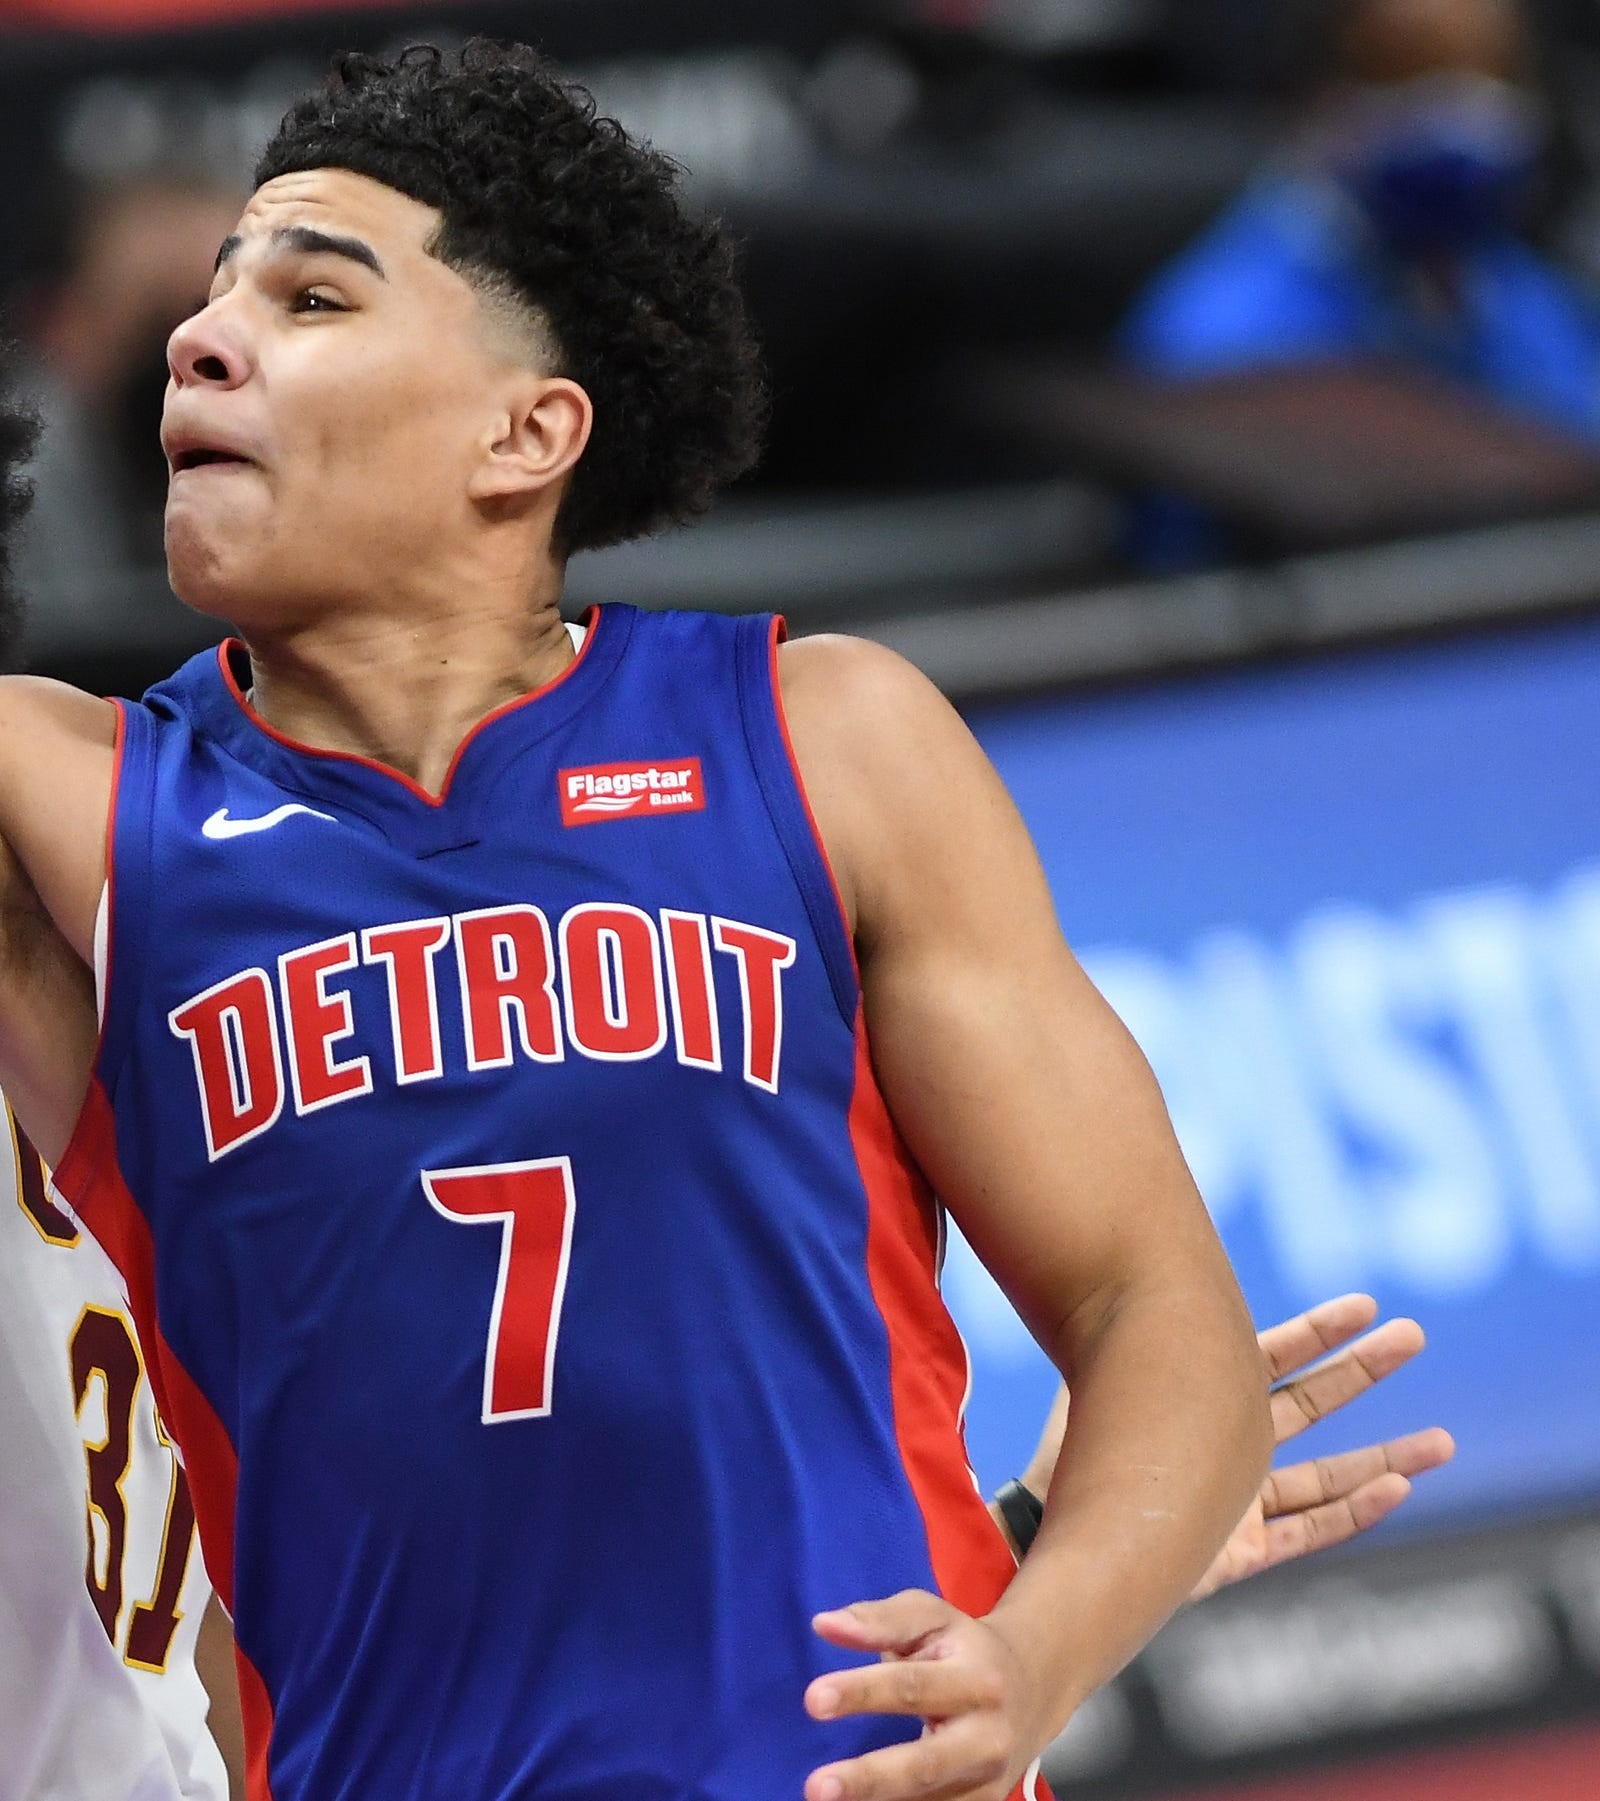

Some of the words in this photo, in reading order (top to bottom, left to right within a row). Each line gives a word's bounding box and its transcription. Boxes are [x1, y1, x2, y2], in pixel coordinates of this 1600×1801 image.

[567, 768, 692, 799] Flagstar
[649, 790, 694, 806] Bank
[168, 901, 797, 1162] DETROIT
[421, 1155, 576, 1424] 7
[68, 1301, 198, 1674] 31
